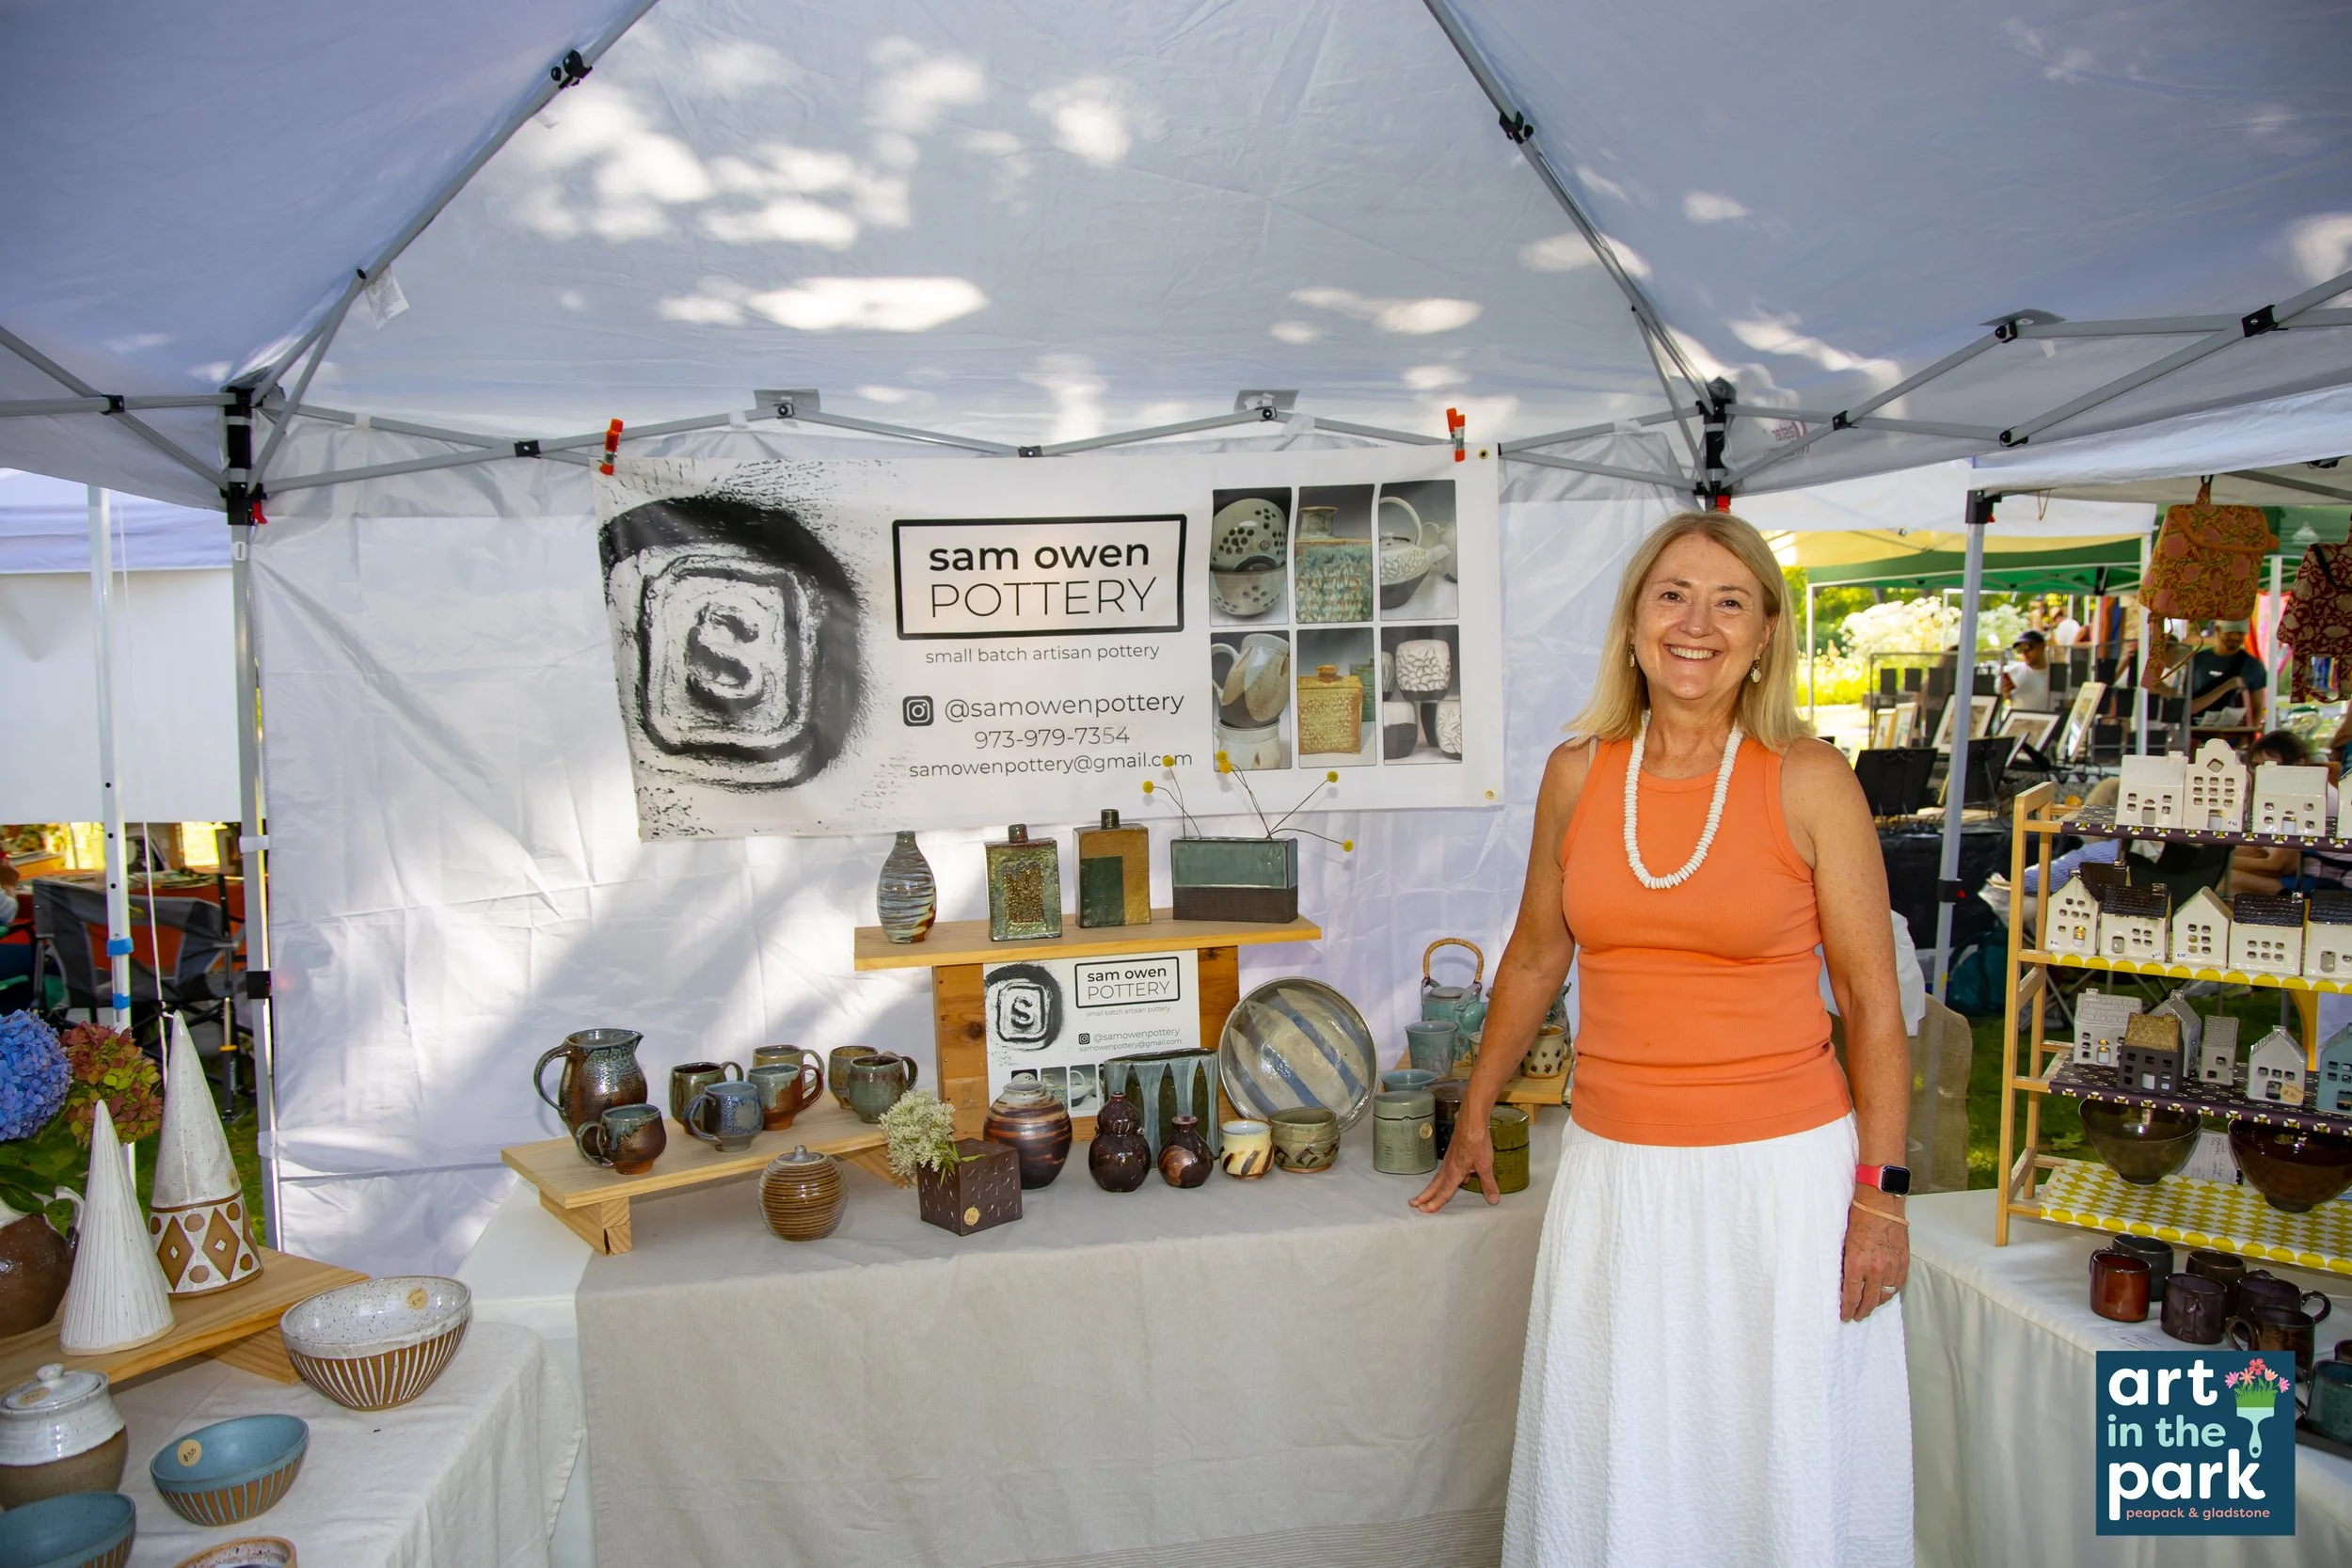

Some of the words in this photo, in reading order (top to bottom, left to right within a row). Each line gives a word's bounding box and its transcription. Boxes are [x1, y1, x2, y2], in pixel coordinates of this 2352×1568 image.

[930, 546, 1019, 572] sam
[1034, 543, 1150, 570] owen
[930, 576, 1157, 618] POTTERY
[925, 648, 972, 664] small
[977, 646, 1027, 662] batch
[1032, 645, 1091, 660] artisan
[1097, 644, 1160, 661] pottery
[945, 693, 1185, 723] @samowenpottery
[974, 726, 1131, 750] 973-979-7354
[909, 752, 1193, 779] samowenpottery@gmail.cm
[1087, 969, 1120, 983] sam
[1124, 966, 1168, 980] owen
[1087, 980, 1171, 1001] POTTERY
[1086, 1008, 1104, 1018] small
[1104, 1006, 1124, 1017] batch
[1124, 1006, 1147, 1015] artisan
[1147, 1005, 1171, 1014] pottery
[1078, 1038, 1183, 1053] samowenpottery@gmail.com
[1092, 1027, 1182, 1044] @samowenpottery
